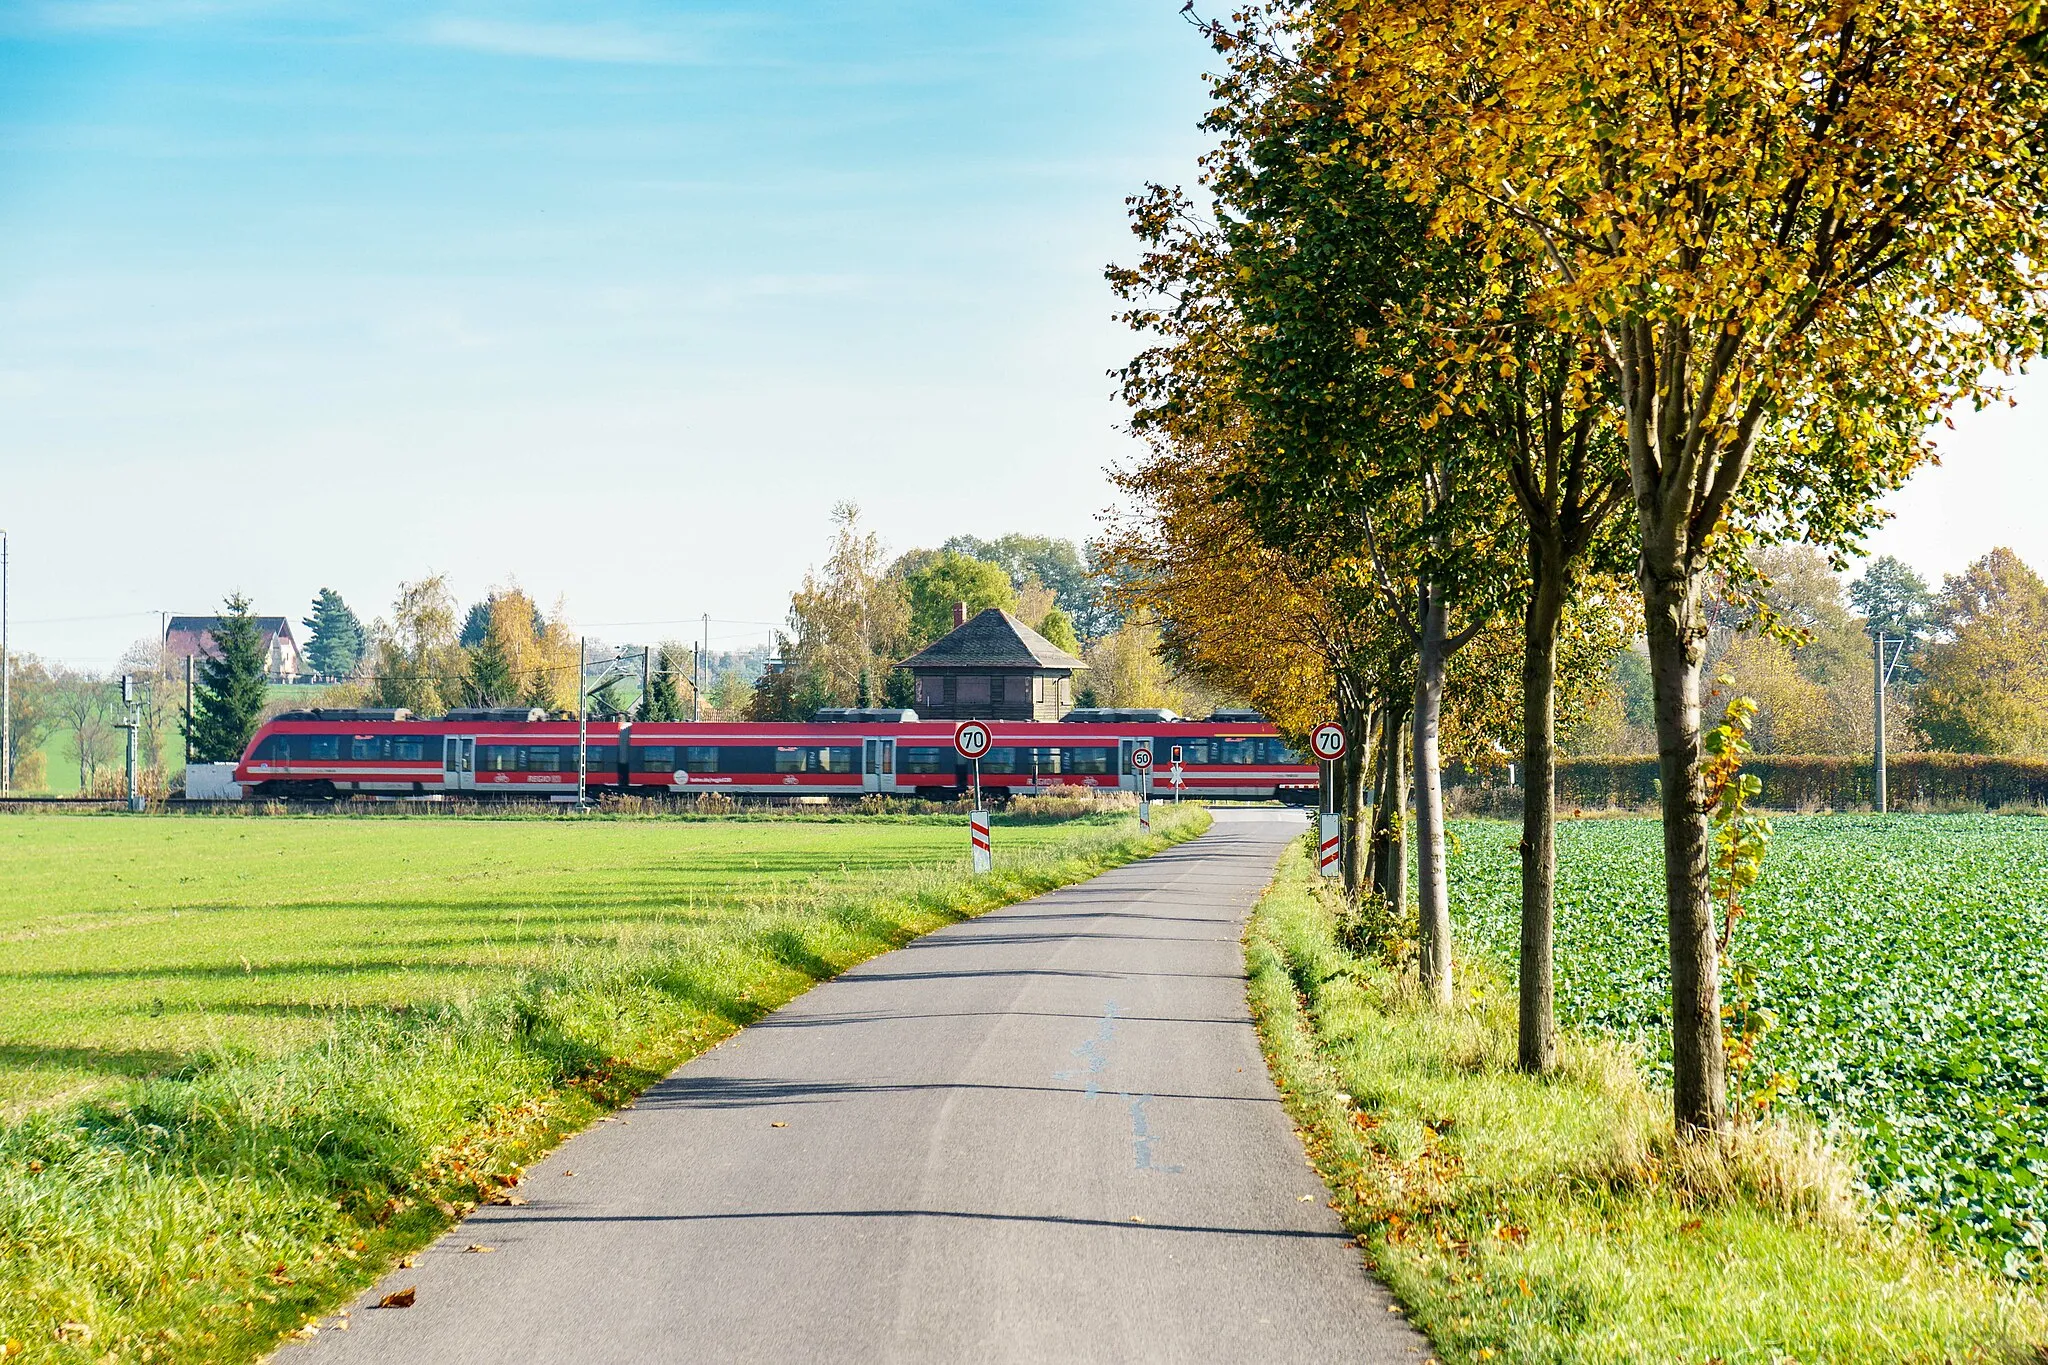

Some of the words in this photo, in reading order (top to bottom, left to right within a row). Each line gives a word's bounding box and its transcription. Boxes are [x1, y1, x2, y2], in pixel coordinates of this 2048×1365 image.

[963, 731, 984, 749] 70
[1320, 733, 1340, 750] 70
[1136, 754, 1149, 763] 50
